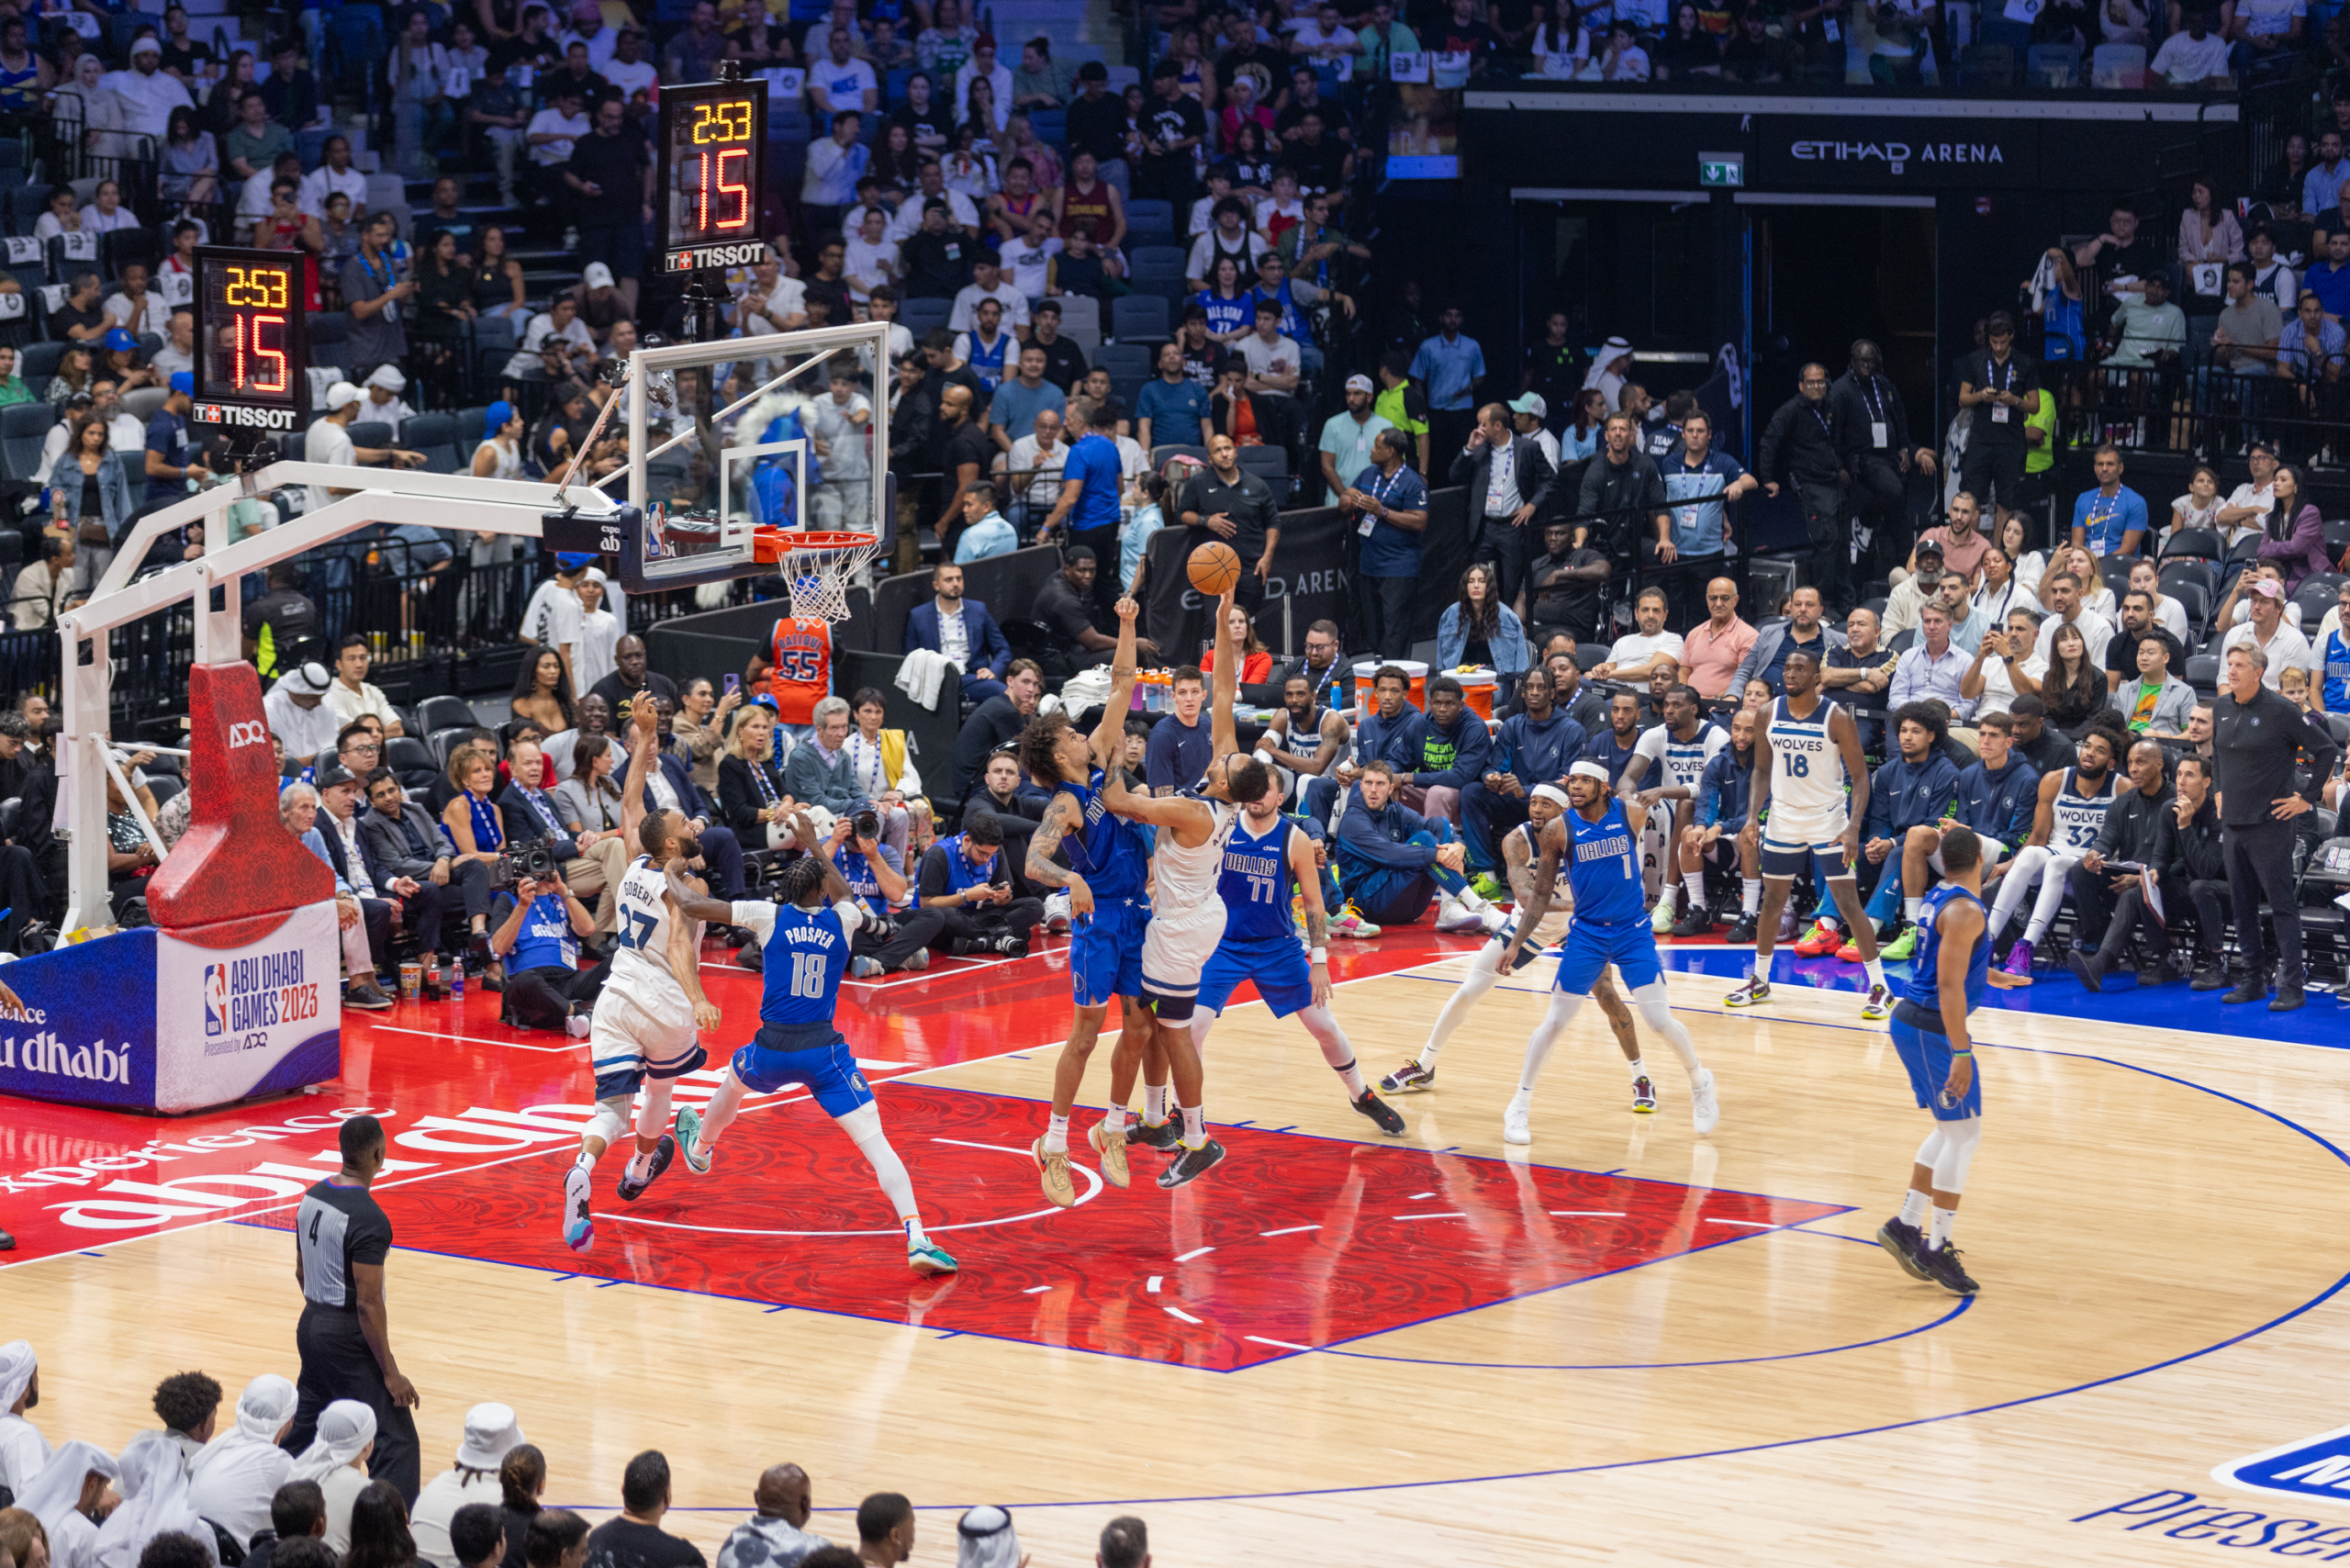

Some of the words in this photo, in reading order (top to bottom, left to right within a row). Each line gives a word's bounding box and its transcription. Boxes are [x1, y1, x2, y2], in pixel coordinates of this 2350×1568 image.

[693, 101, 752, 144] 2:53
[1791, 140, 1911, 162] ETIHAD
[1921, 142, 2003, 162] ARENA
[699, 148, 749, 230] 15
[693, 243, 765, 268] TISSOT
[226, 267, 287, 308] 2:53
[235, 313, 286, 392] 15
[221, 405, 297, 430] TISSOT
[1295, 567, 1349, 596] AREN
[778, 649, 822, 682] 55
[1771, 737, 1823, 752] WOLVES
[1666, 760, 1705, 771] WOLVES
[1783, 753, 1809, 778] 18
[2059, 810, 2107, 824] WOLVE
[1576, 834, 1629, 862] DALLAS
[2066, 825, 2099, 848] 32
[1225, 851, 1278, 877] DALLAS
[1621, 854, 1632, 879] 1
[623, 880, 655, 907] GOBERT
[1247, 875, 1275, 903] 77
[619, 902, 659, 951] 27
[784, 926, 835, 949] PROSPER
[231, 957, 259, 996] ABU
[262, 948, 304, 991] DHABI
[790, 951, 827, 999] 18
[231, 990, 278, 1033] GAMES
[281, 982, 318, 1024] 2023
[207, 1020, 220, 1034] NBA
[204, 1036, 233, 1057] Presented
[234, 1036, 241, 1054] by
[308, 1208, 323, 1247] 4
